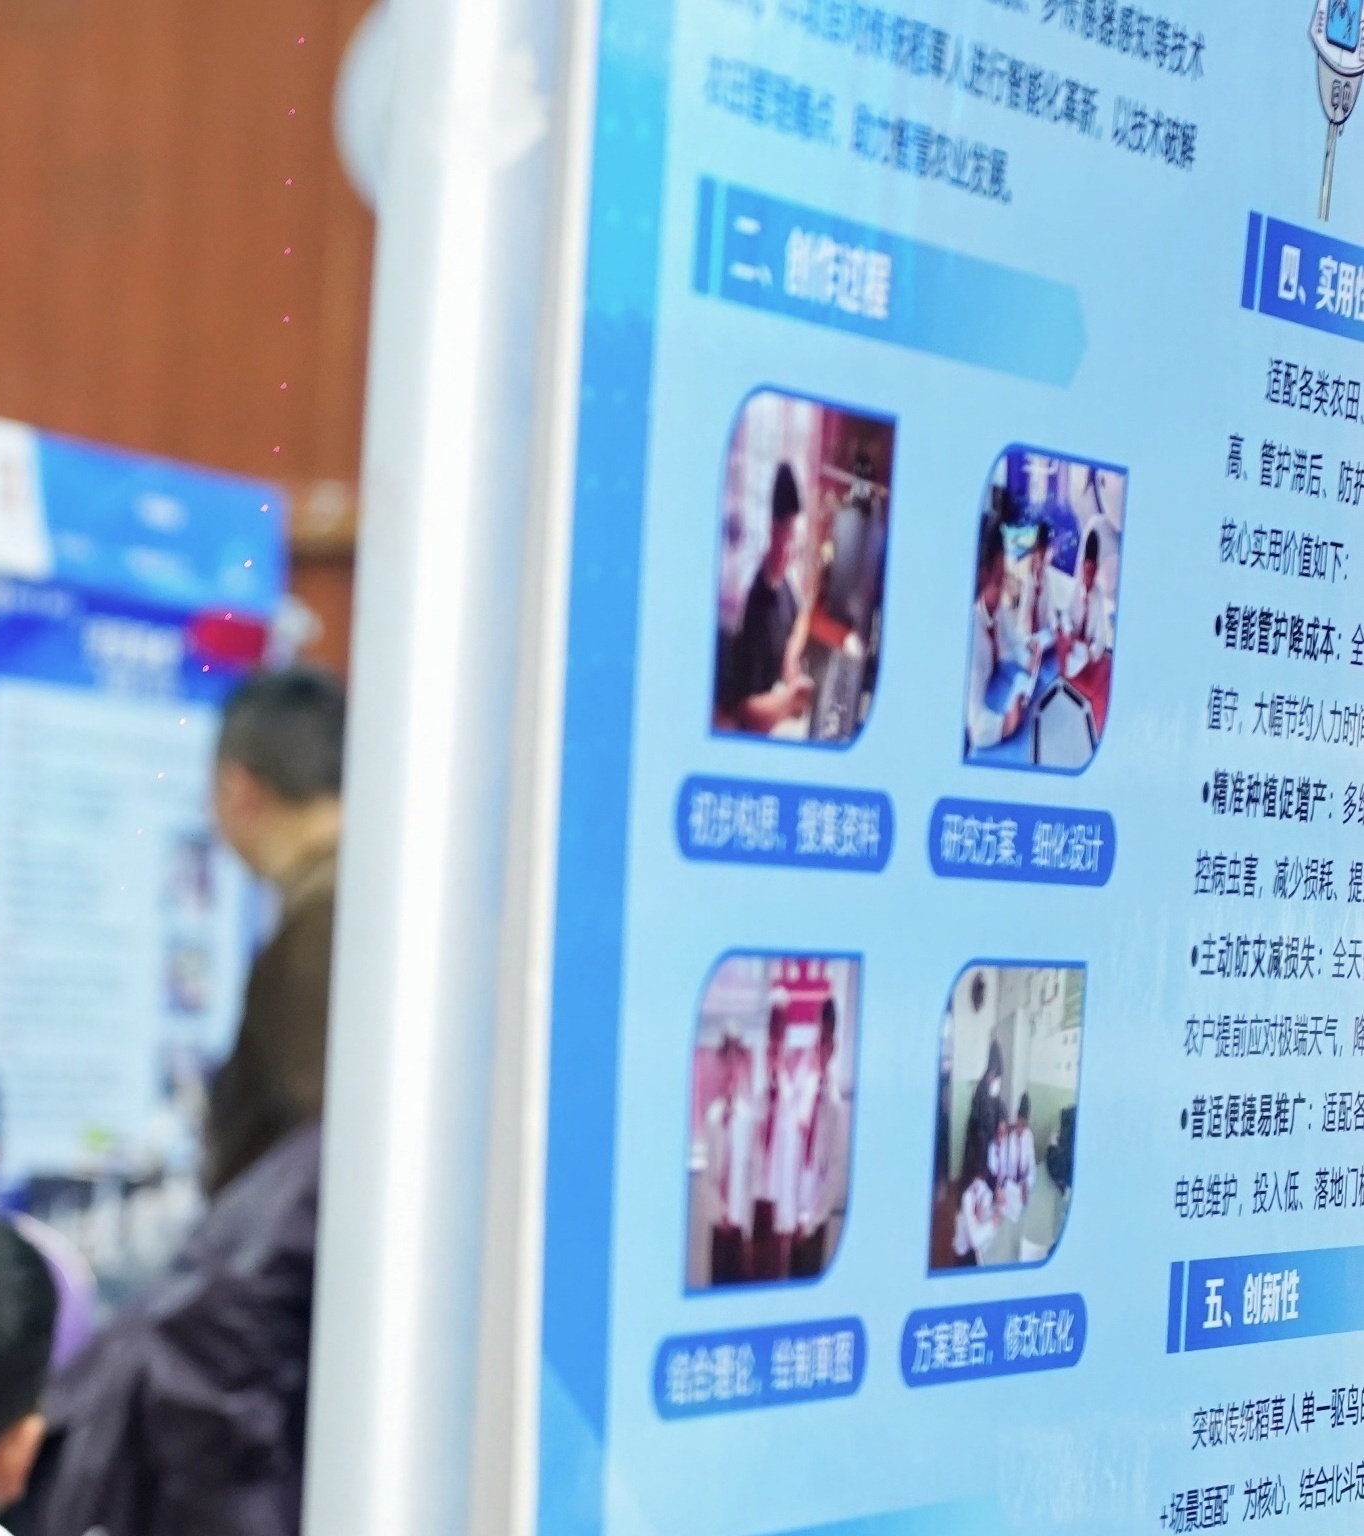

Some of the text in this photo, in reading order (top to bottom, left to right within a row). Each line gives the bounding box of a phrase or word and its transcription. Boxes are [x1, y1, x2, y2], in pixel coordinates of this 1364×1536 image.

[729, 214, 892, 321] 二、创作过程
[1220, 516, 1349, 583] 核心实用价值如下：
[940, 813, 1104, 873] 研究方案，细化设计
[1200, 932, 1364, 980] 主动防灾减损失：全天
[1202, 1268, 1300, 1329] 五、创新性
[911, 1308, 1075, 1374] 方案整合，修改优化
[1191, 1384, 1364, 1451] 突破传统稻草人单一驱鸟
